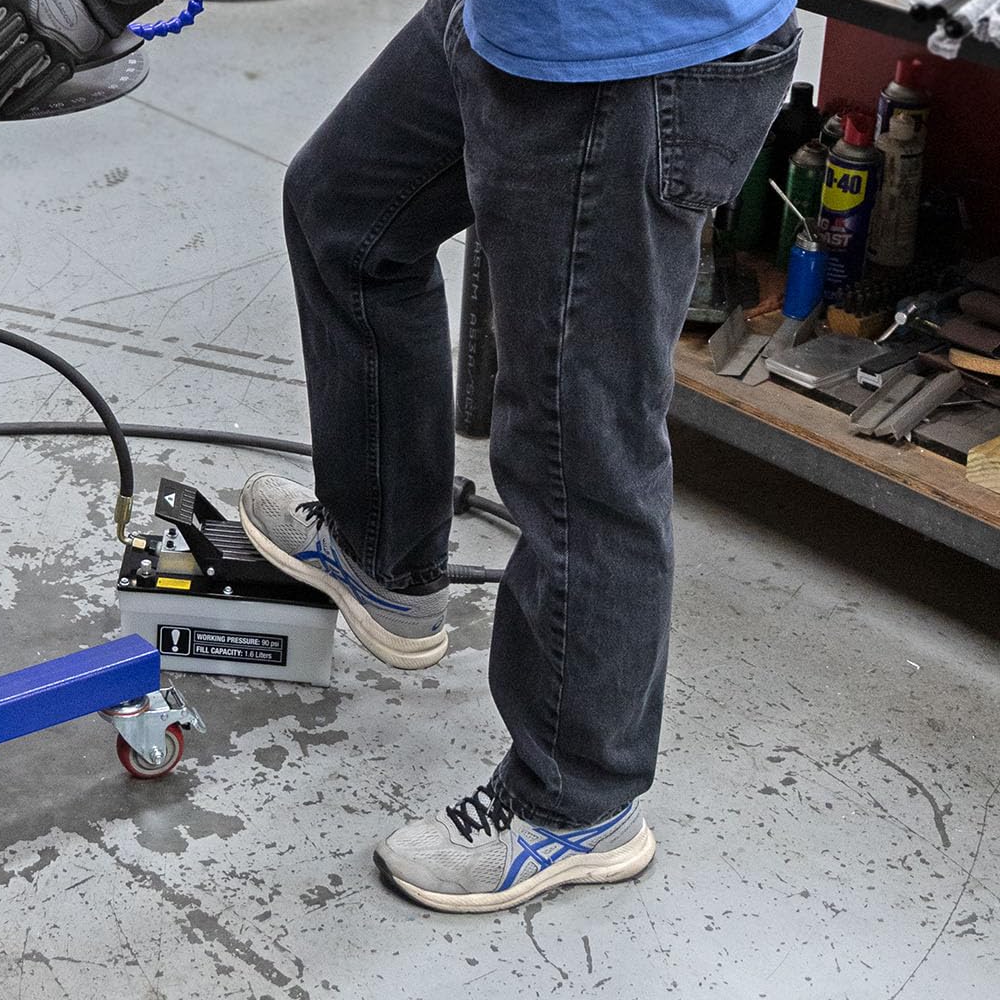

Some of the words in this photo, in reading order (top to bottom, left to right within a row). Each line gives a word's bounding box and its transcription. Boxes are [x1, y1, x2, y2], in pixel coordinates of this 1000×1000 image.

[826, 167, 862, 195] D-40
[196, 633, 226, 643] WORKING
[227, 636, 261, 646] PRESSURE:
[196, 645, 210, 654] FILL
[210, 647, 243, 657] CAPACITY:
[255, 651, 273, 659] Liters
